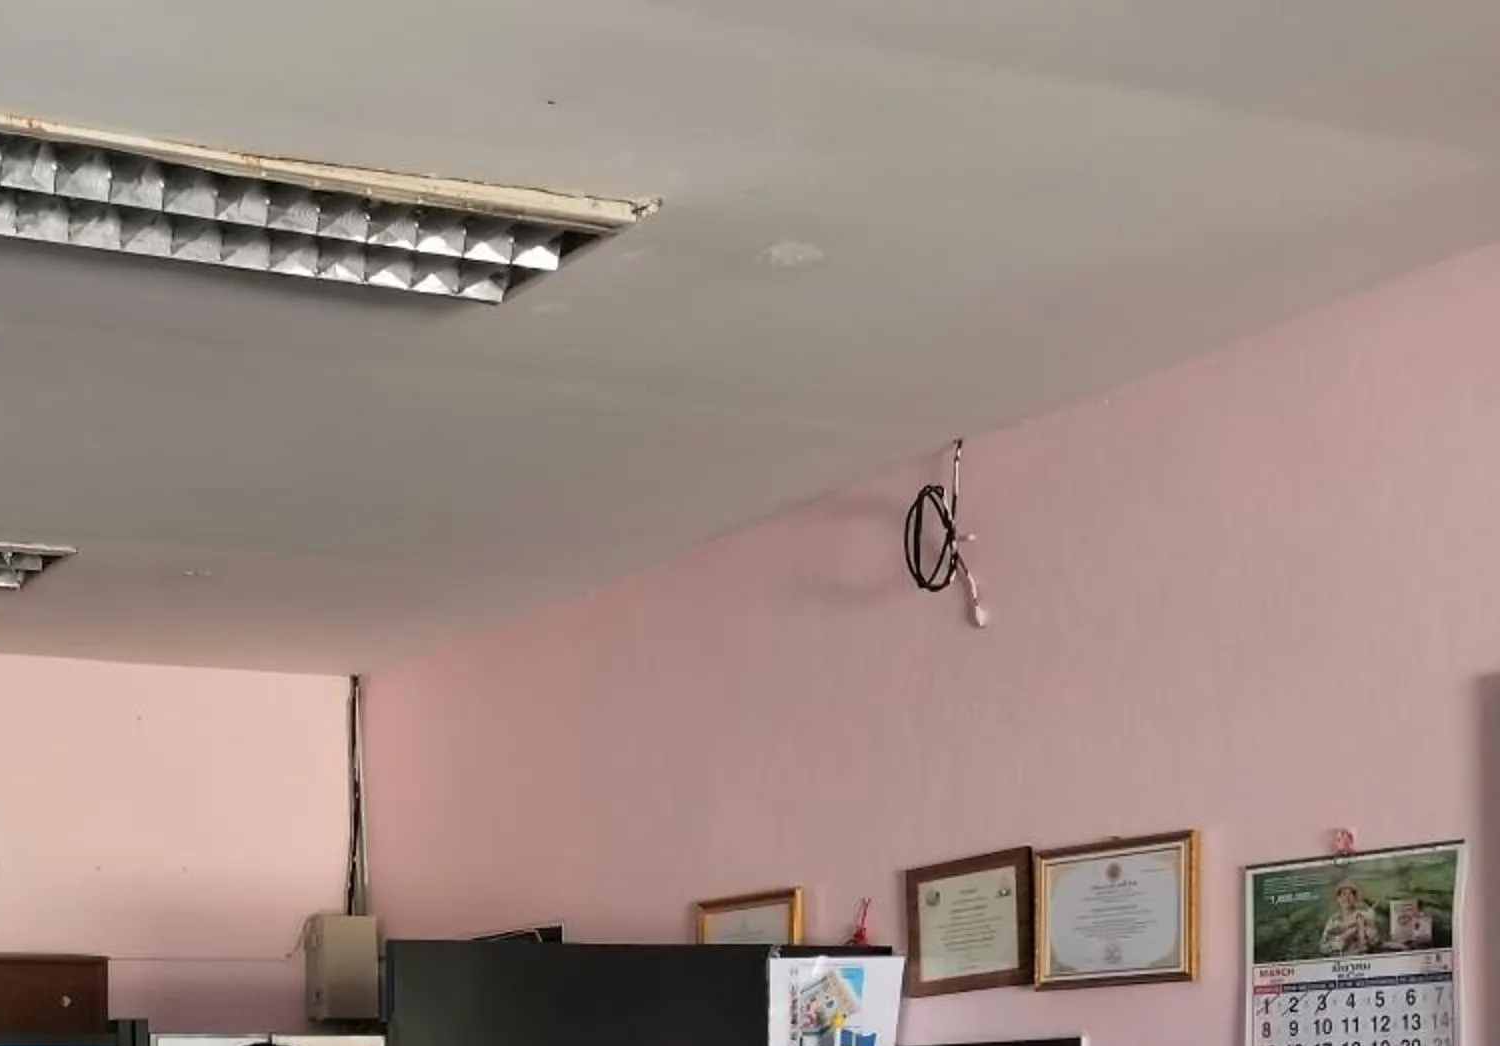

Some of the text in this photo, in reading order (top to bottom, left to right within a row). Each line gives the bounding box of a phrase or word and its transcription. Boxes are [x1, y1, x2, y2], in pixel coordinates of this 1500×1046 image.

[1259, 968, 1295, 978] MARCH
[1263, 998, 1270, 1014] 1
[1288, 997, 1299, 1013] 2
[1317, 995, 1327, 1011] 3
[1345, 993, 1355, 1008] 4
[1375, 991, 1385, 1007] 5
[1405, 989, 1416, 1005] 6
[1261, 1022, 1271, 1038] 8
[1289, 1020, 1299, 1037] 9
[1314, 1019, 1333, 1035] 10
[1341, 1017, 1360, 1033] 11
[1371, 1015, 1391, 1032] 12
[1402, 1014, 1421, 1030] 13
